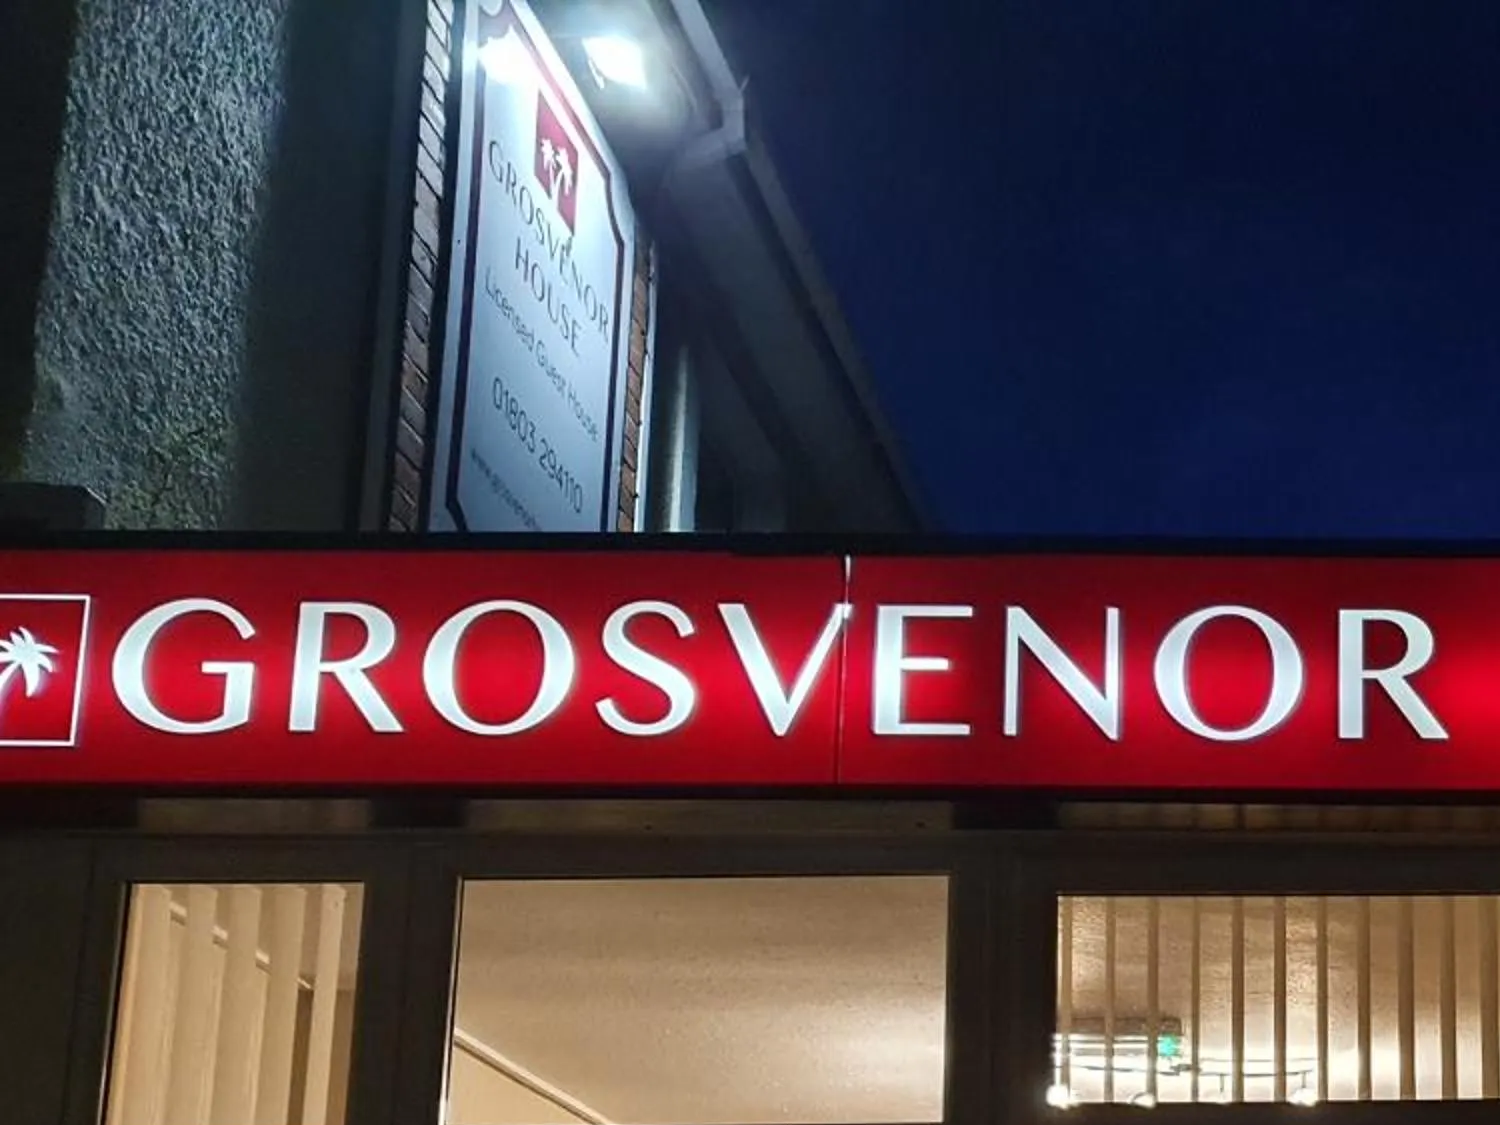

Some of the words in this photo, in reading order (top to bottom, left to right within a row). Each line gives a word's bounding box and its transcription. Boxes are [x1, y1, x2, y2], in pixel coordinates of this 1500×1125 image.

[488, 139, 609, 343] GROSVENOR
[514, 235, 582, 358] HOUSE
[492, 376, 538, 454] 01803
[110, 597, 1450, 743] GROSVENOR
